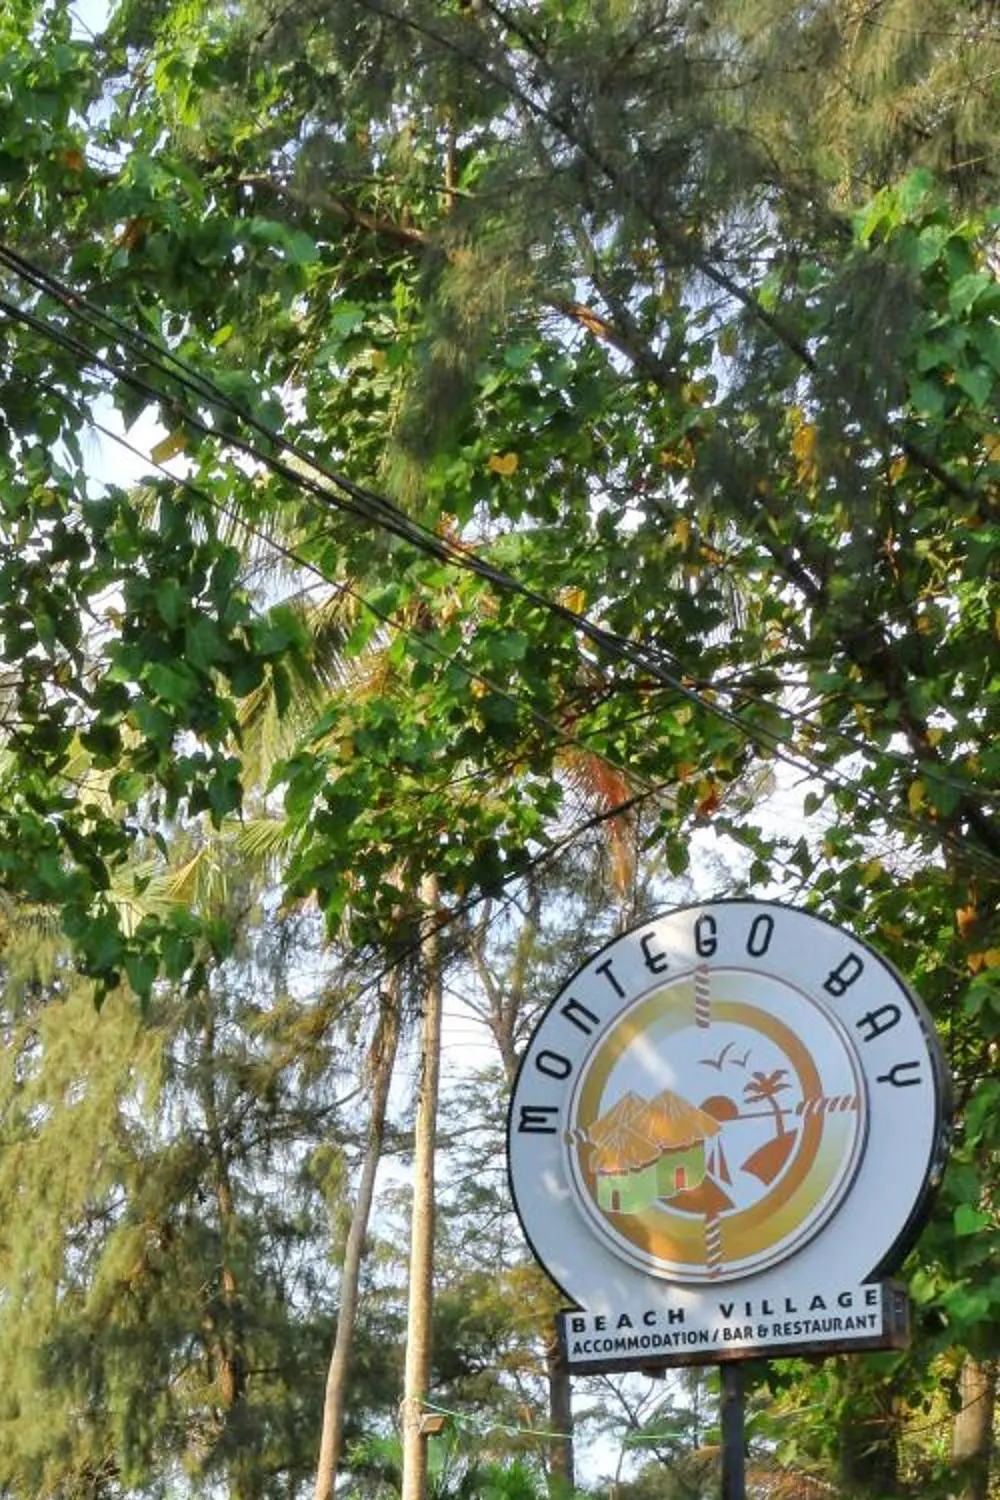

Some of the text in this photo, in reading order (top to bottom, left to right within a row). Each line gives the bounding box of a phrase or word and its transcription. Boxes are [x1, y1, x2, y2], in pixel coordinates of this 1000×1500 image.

[518, 913, 922, 1135] MONTEGO BAY
[572, 1288, 878, 1334] BEACH VILLAGE
[572, 1330, 710, 1355] ACCOMMODATION
[723, 1324, 753, 1342] BAR
[757, 1324, 769, 1339] &
[772, 1313, 877, 1336] RESTAURANT
